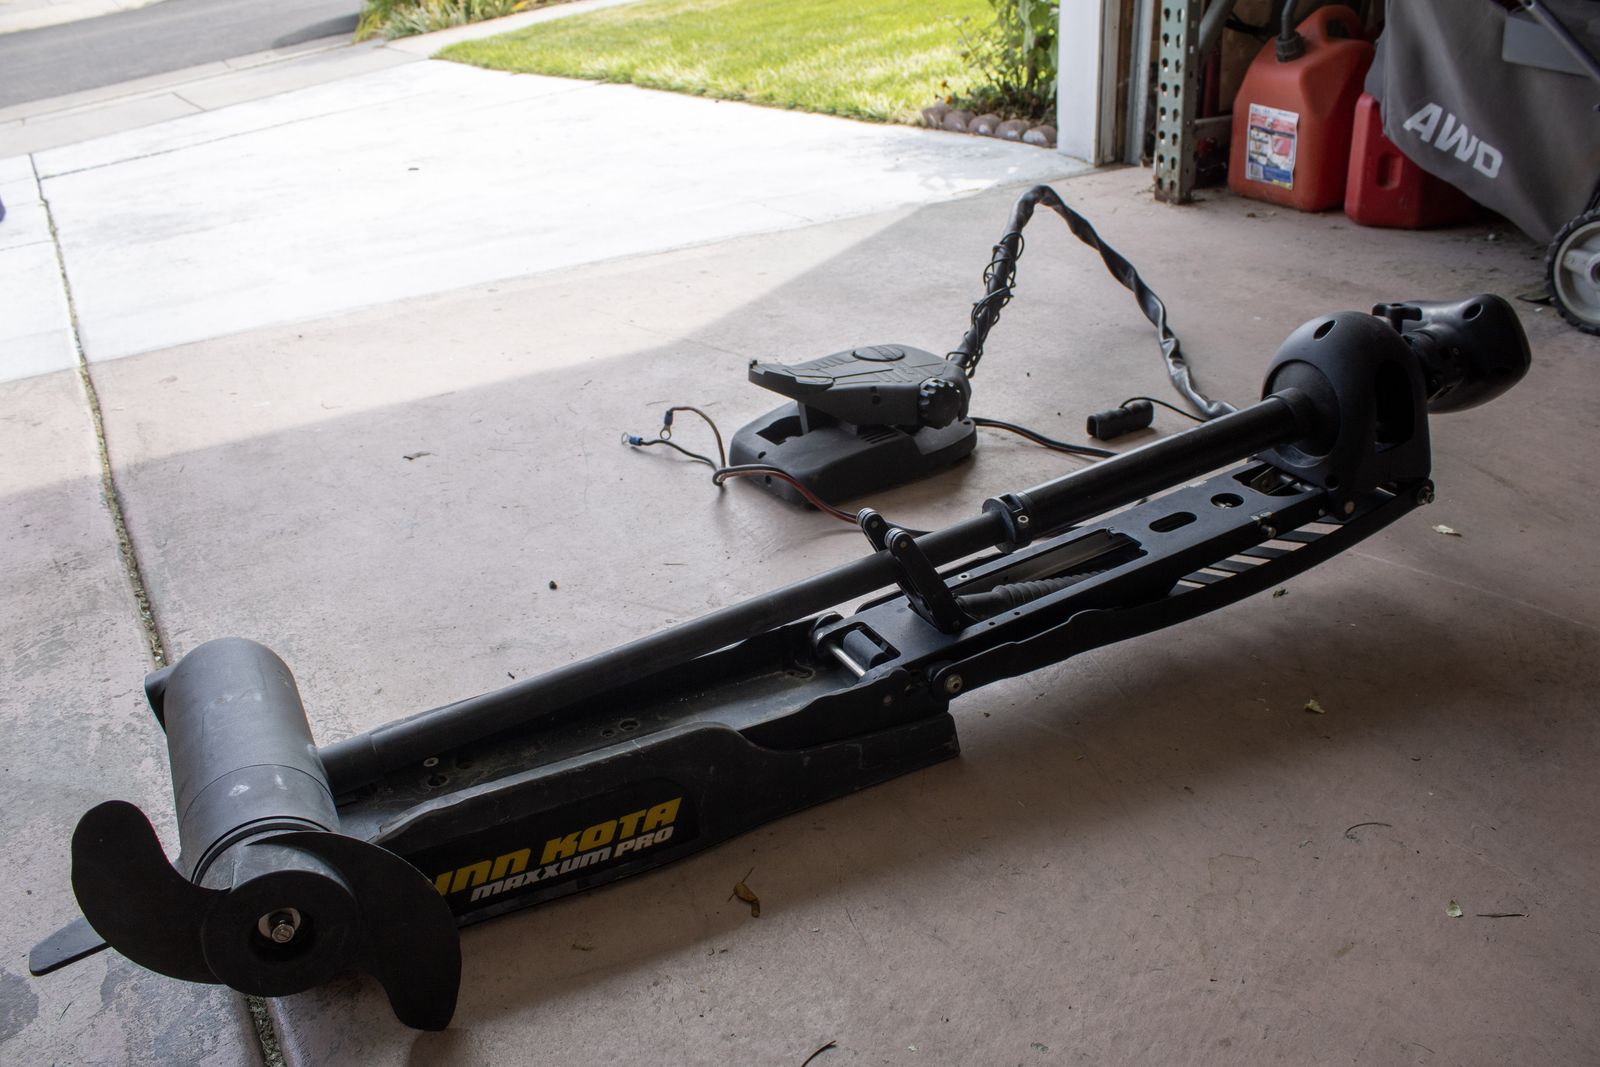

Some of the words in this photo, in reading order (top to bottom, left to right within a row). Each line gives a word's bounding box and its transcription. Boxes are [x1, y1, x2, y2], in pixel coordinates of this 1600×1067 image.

[1403, 102, 1504, 179] AWD
[434, 847, 532, 896] INN
[540, 797, 682, 865] KOTA
[470, 846, 612, 902] MAXXUM
[614, 826, 675, 858] PRO
